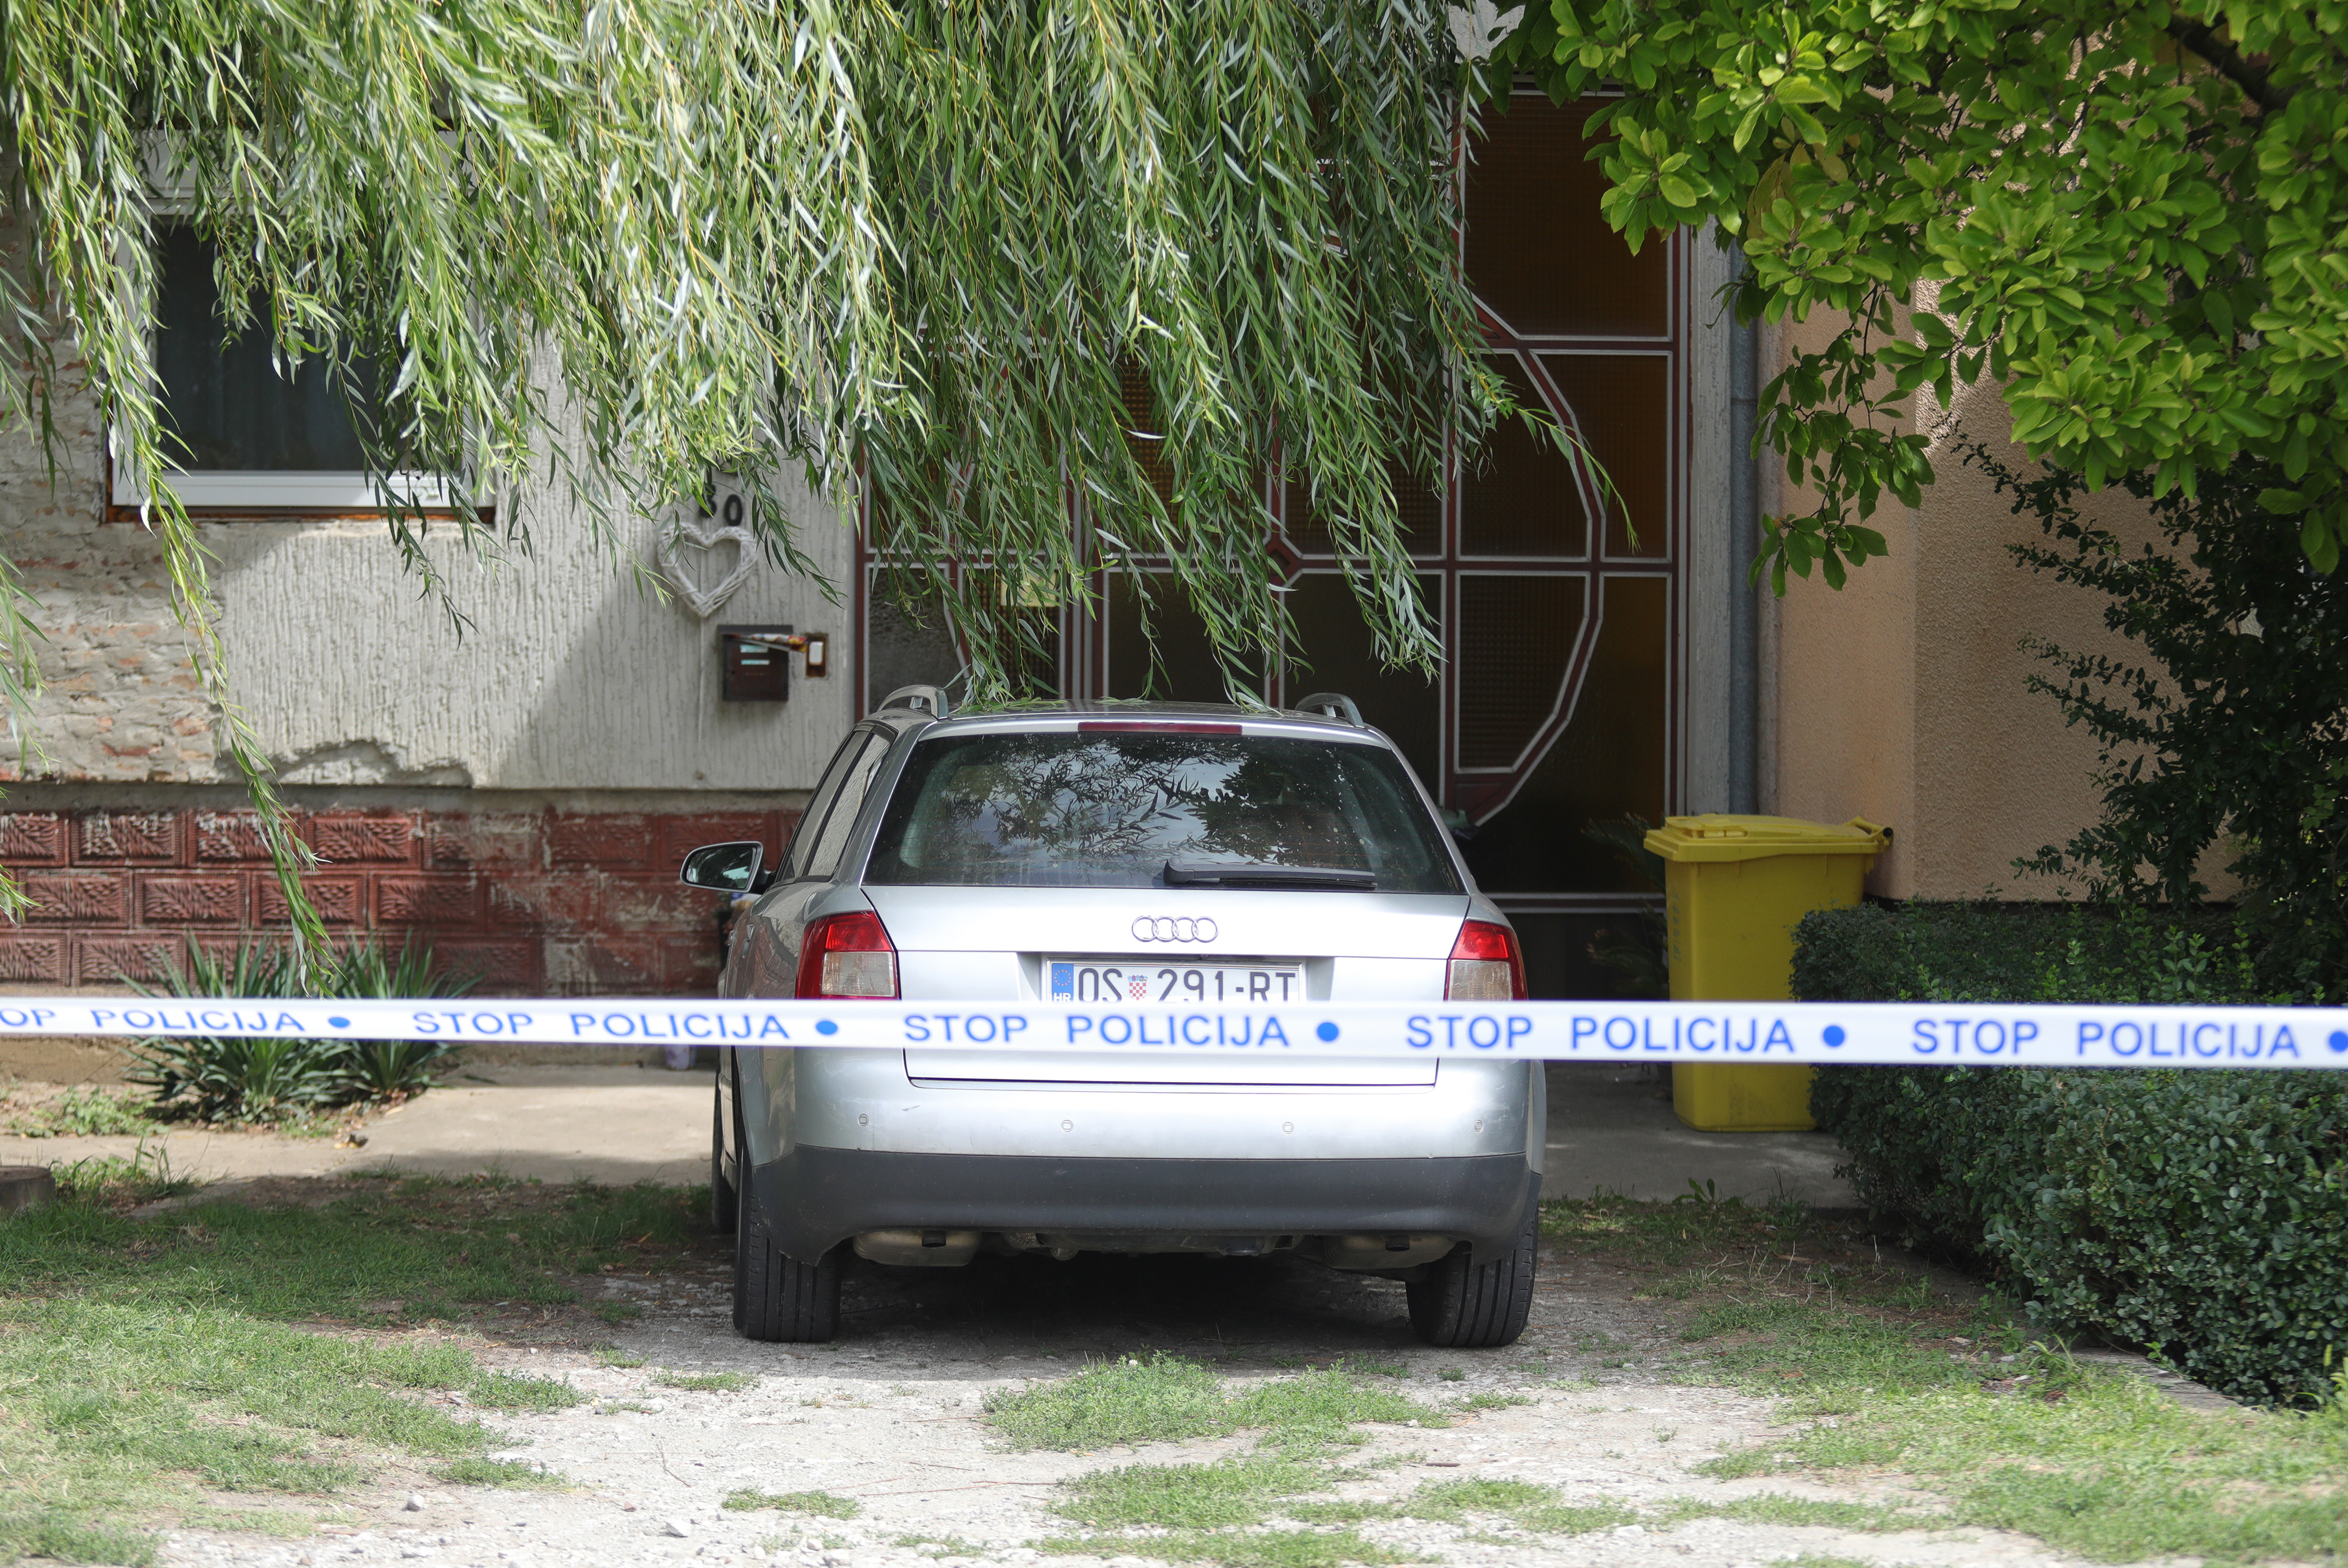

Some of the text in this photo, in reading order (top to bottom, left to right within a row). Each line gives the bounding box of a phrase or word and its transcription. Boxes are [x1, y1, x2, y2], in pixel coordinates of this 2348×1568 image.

[1053, 992, 1071, 1003] HR
[1078, 968, 1122, 1003] OS
[90, 1009, 306, 1032] POLICIJA
[412, 1012, 533, 1035] STOP
[569, 1012, 791, 1040] POLICIJA
[903, 1013, 1028, 1043] STOP
[1065, 1013, 1291, 1048] POLICIJA
[1405, 1014, 1534, 1050] STOP
[1570, 1015, 1797, 1055] POLICIJA
[1911, 1017, 2040, 1057] STOP
[2075, 1020, 2302, 1060] POLICIJA
